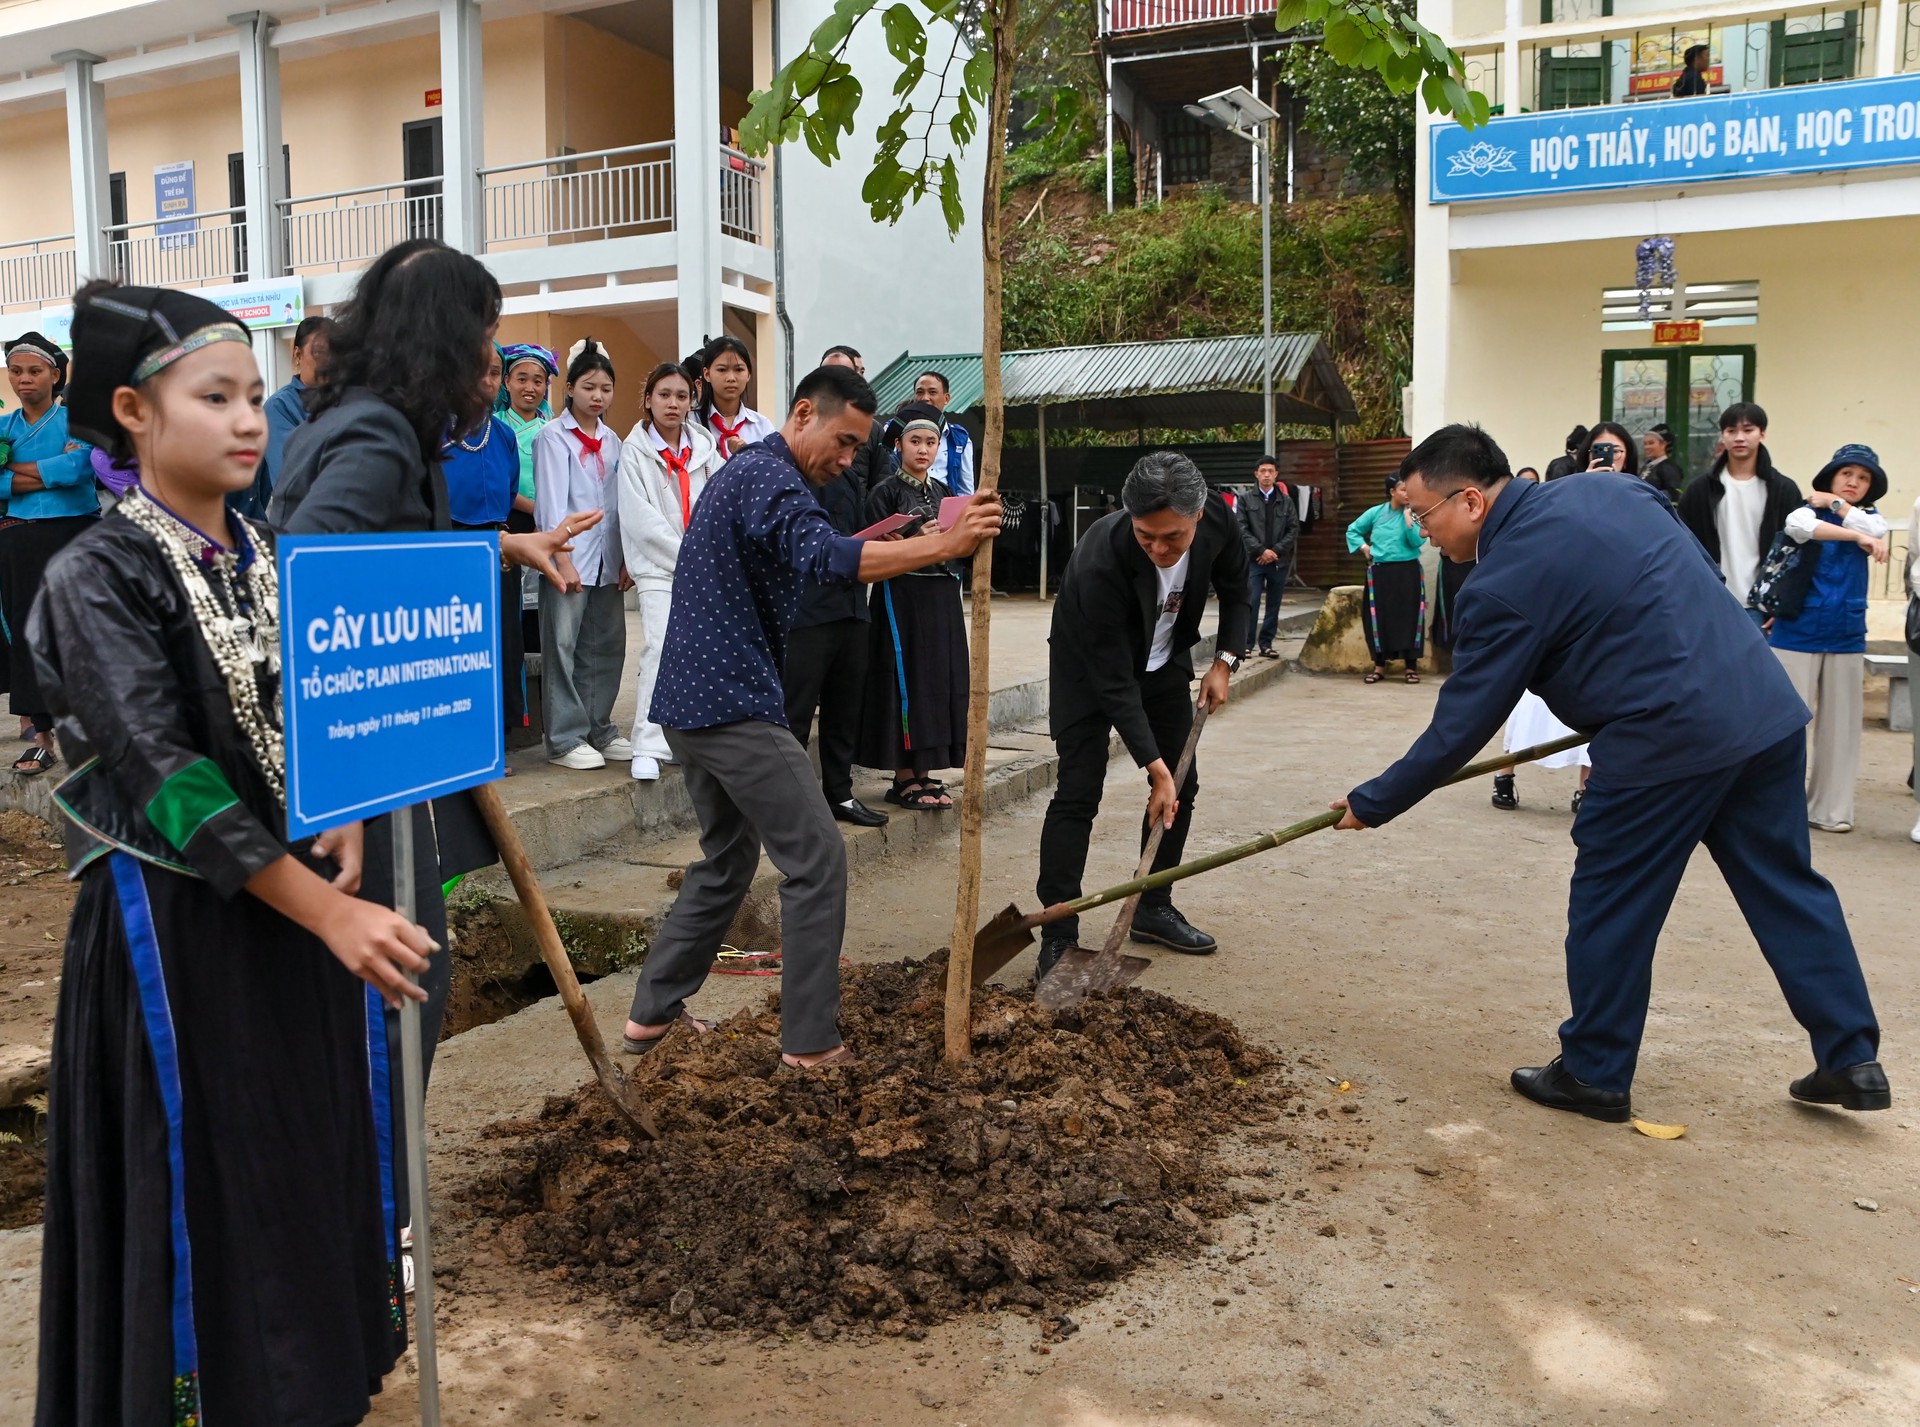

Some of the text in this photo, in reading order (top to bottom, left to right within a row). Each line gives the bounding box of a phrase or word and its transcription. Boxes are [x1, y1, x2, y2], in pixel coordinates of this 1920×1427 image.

[1530, 100, 1920, 180] HỌC THẦY, HỌC BẠN, HỌC TRO
[240, 295, 256, 304] THCS
[244, 307, 269, 316] SCHOOL
[306, 594, 483, 654] CÂY LƯU NIỆM
[301, 650, 492, 700] TỔ CHỨC PLAN INTERNATIONAL
[356, 716, 380, 736] ngày
[381, 713, 393, 728] 11
[394, 709, 420, 726] tháng
[421, 706, 431, 720] 11
[433, 703, 452, 718] năm
[452, 698, 472, 714] 2025
